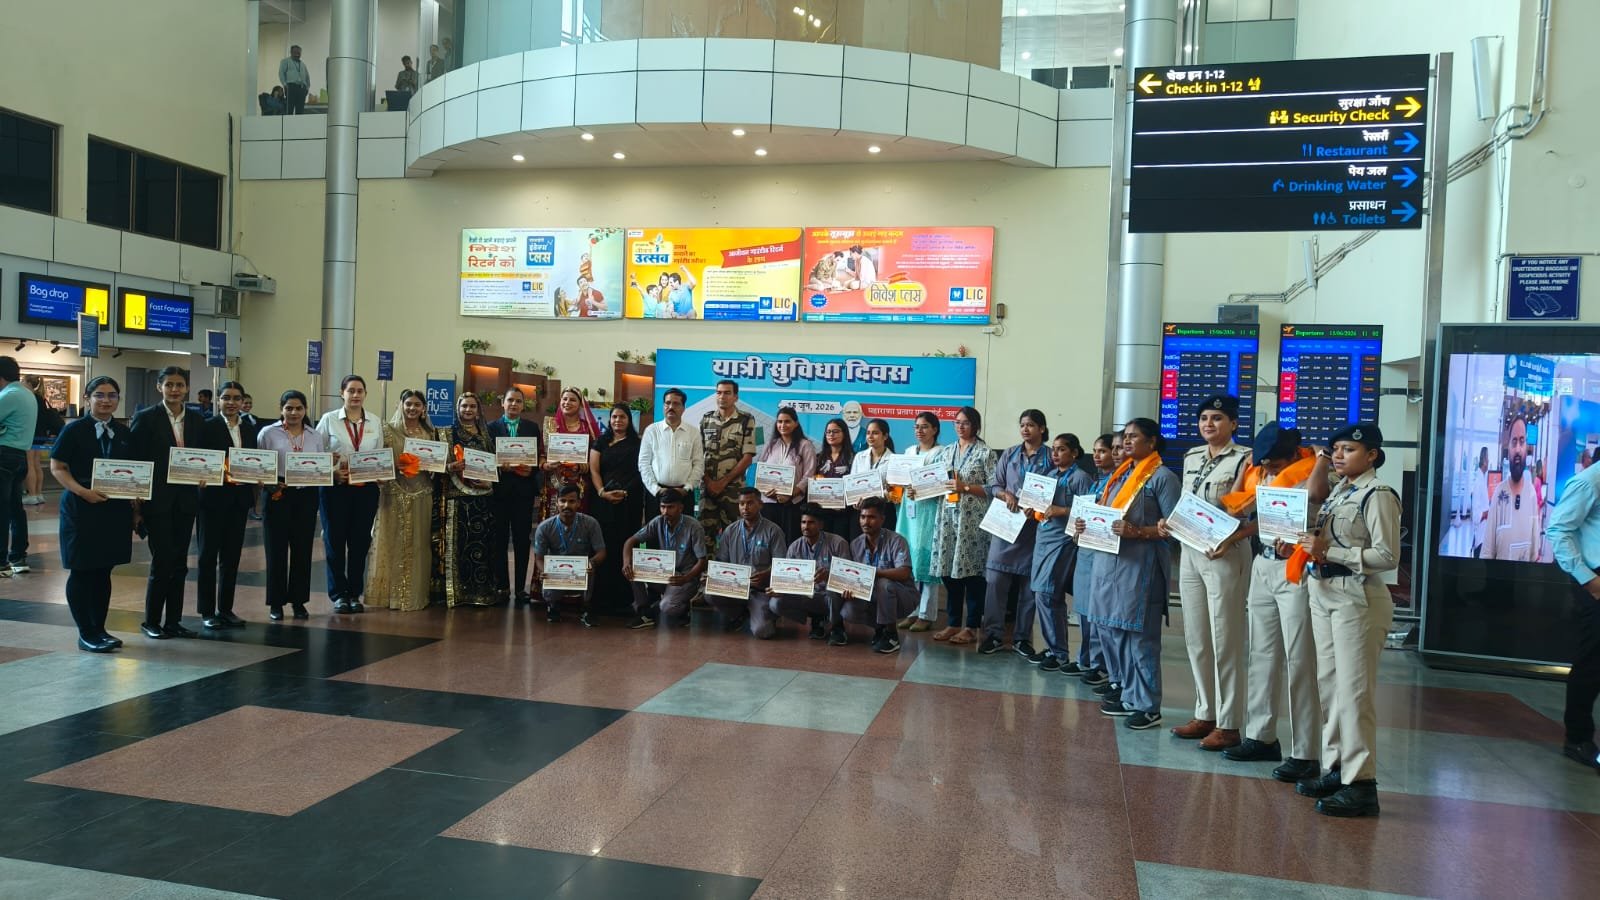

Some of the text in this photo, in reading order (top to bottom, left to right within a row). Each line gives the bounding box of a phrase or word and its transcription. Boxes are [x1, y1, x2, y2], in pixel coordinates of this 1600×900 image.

[1204, 70, 1224, 80] 1-12
[1166, 82, 1243, 94] Check in 1-12
[1338, 95, 1392, 110] सुरक्षा जाँच
[1293, 110, 1390, 125] Security Check
[1316, 145, 1388, 157] Restaurant
[1348, 165, 1388, 176] पेय जल
[1289, 180, 1387, 194] Drinking Water
[1349, 200, 1386, 210] प्रसाधन
[1342, 214, 1386, 224] Toilets
[468, 255, 516, 268] रिटर्न को
[528, 252, 552, 264] प्लस
[634, 254, 670, 264] उत्सव
[30, 284, 69, 300] Bag drop
[532, 282, 544, 290] LIC
[870, 283, 922, 302] निवेश प्लस
[966, 288, 984, 300] LIC
[150, 302, 189, 314] Fast Forward
[774, 297, 791, 308] LIC
[134, 315, 143, 326] 12
[712, 356, 912, 387] यात्री सुविधा दिवस
[427, 388, 448, 400] Fit &
[427, 401, 440, 415] fly
[798, 402, 813, 411] जून,
[868, 407, 895, 415] महाराणा
